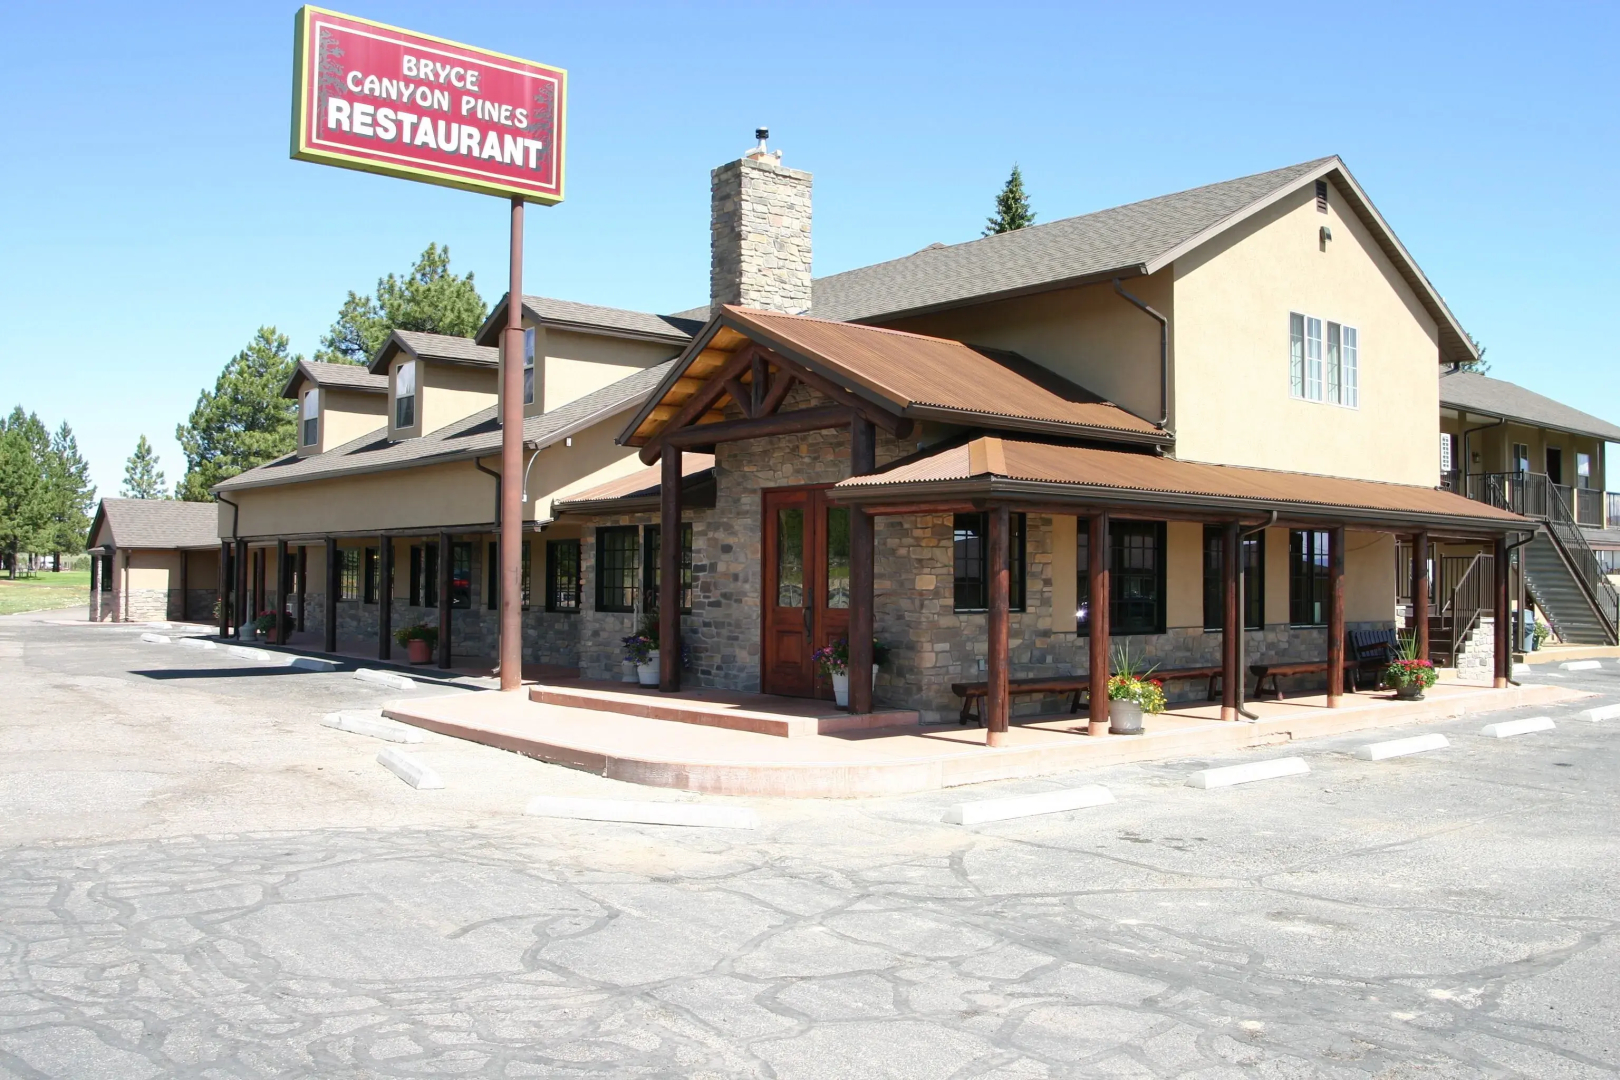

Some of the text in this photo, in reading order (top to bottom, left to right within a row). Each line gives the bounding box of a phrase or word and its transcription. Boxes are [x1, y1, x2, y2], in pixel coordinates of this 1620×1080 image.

[346, 71, 528, 128] CANYON PINES
[402, 54, 479, 92] BRYCE
[327, 97, 542, 169] RESTAURANT
